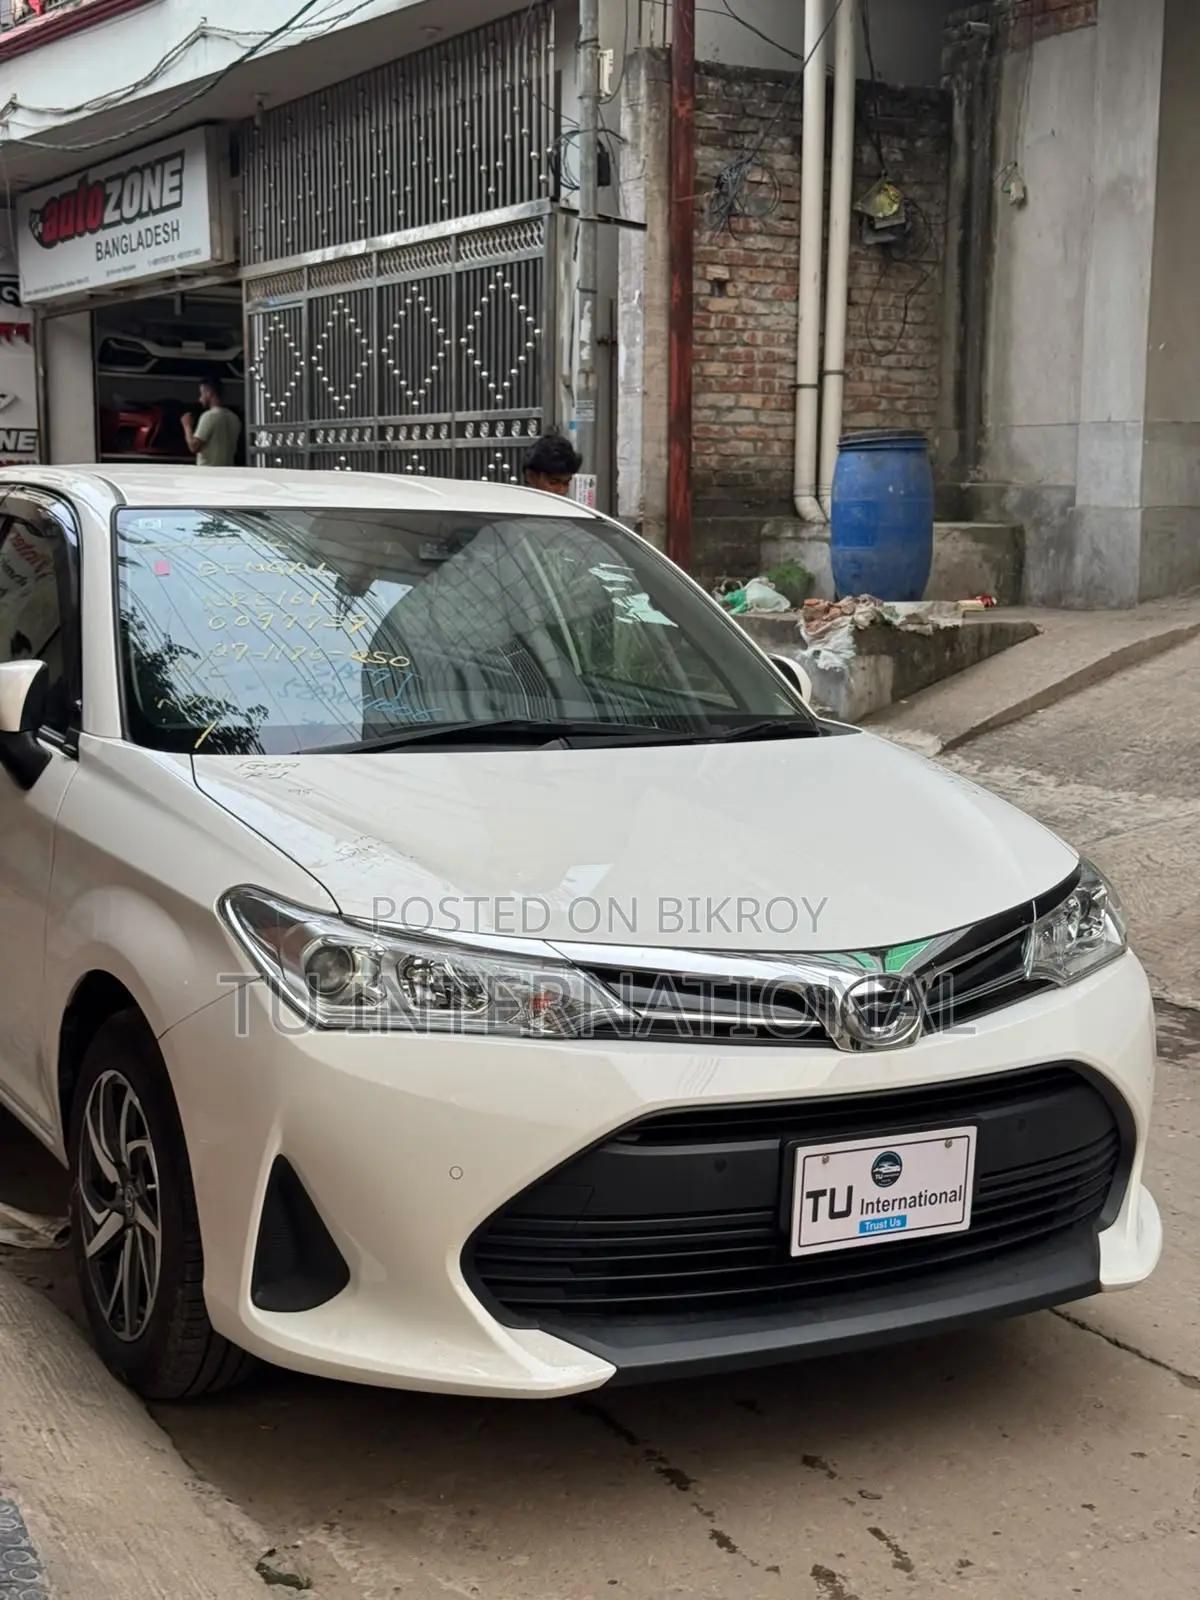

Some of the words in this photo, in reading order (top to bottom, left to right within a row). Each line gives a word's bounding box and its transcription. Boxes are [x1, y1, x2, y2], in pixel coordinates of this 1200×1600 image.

[95, 219, 180, 262] BANGLADESH
[805, 1185, 854, 1223] TU
[860, 1184, 963, 1216] International
[864, 1220, 889, 1231] Trust
[889, 1219, 902, 1229] Us
